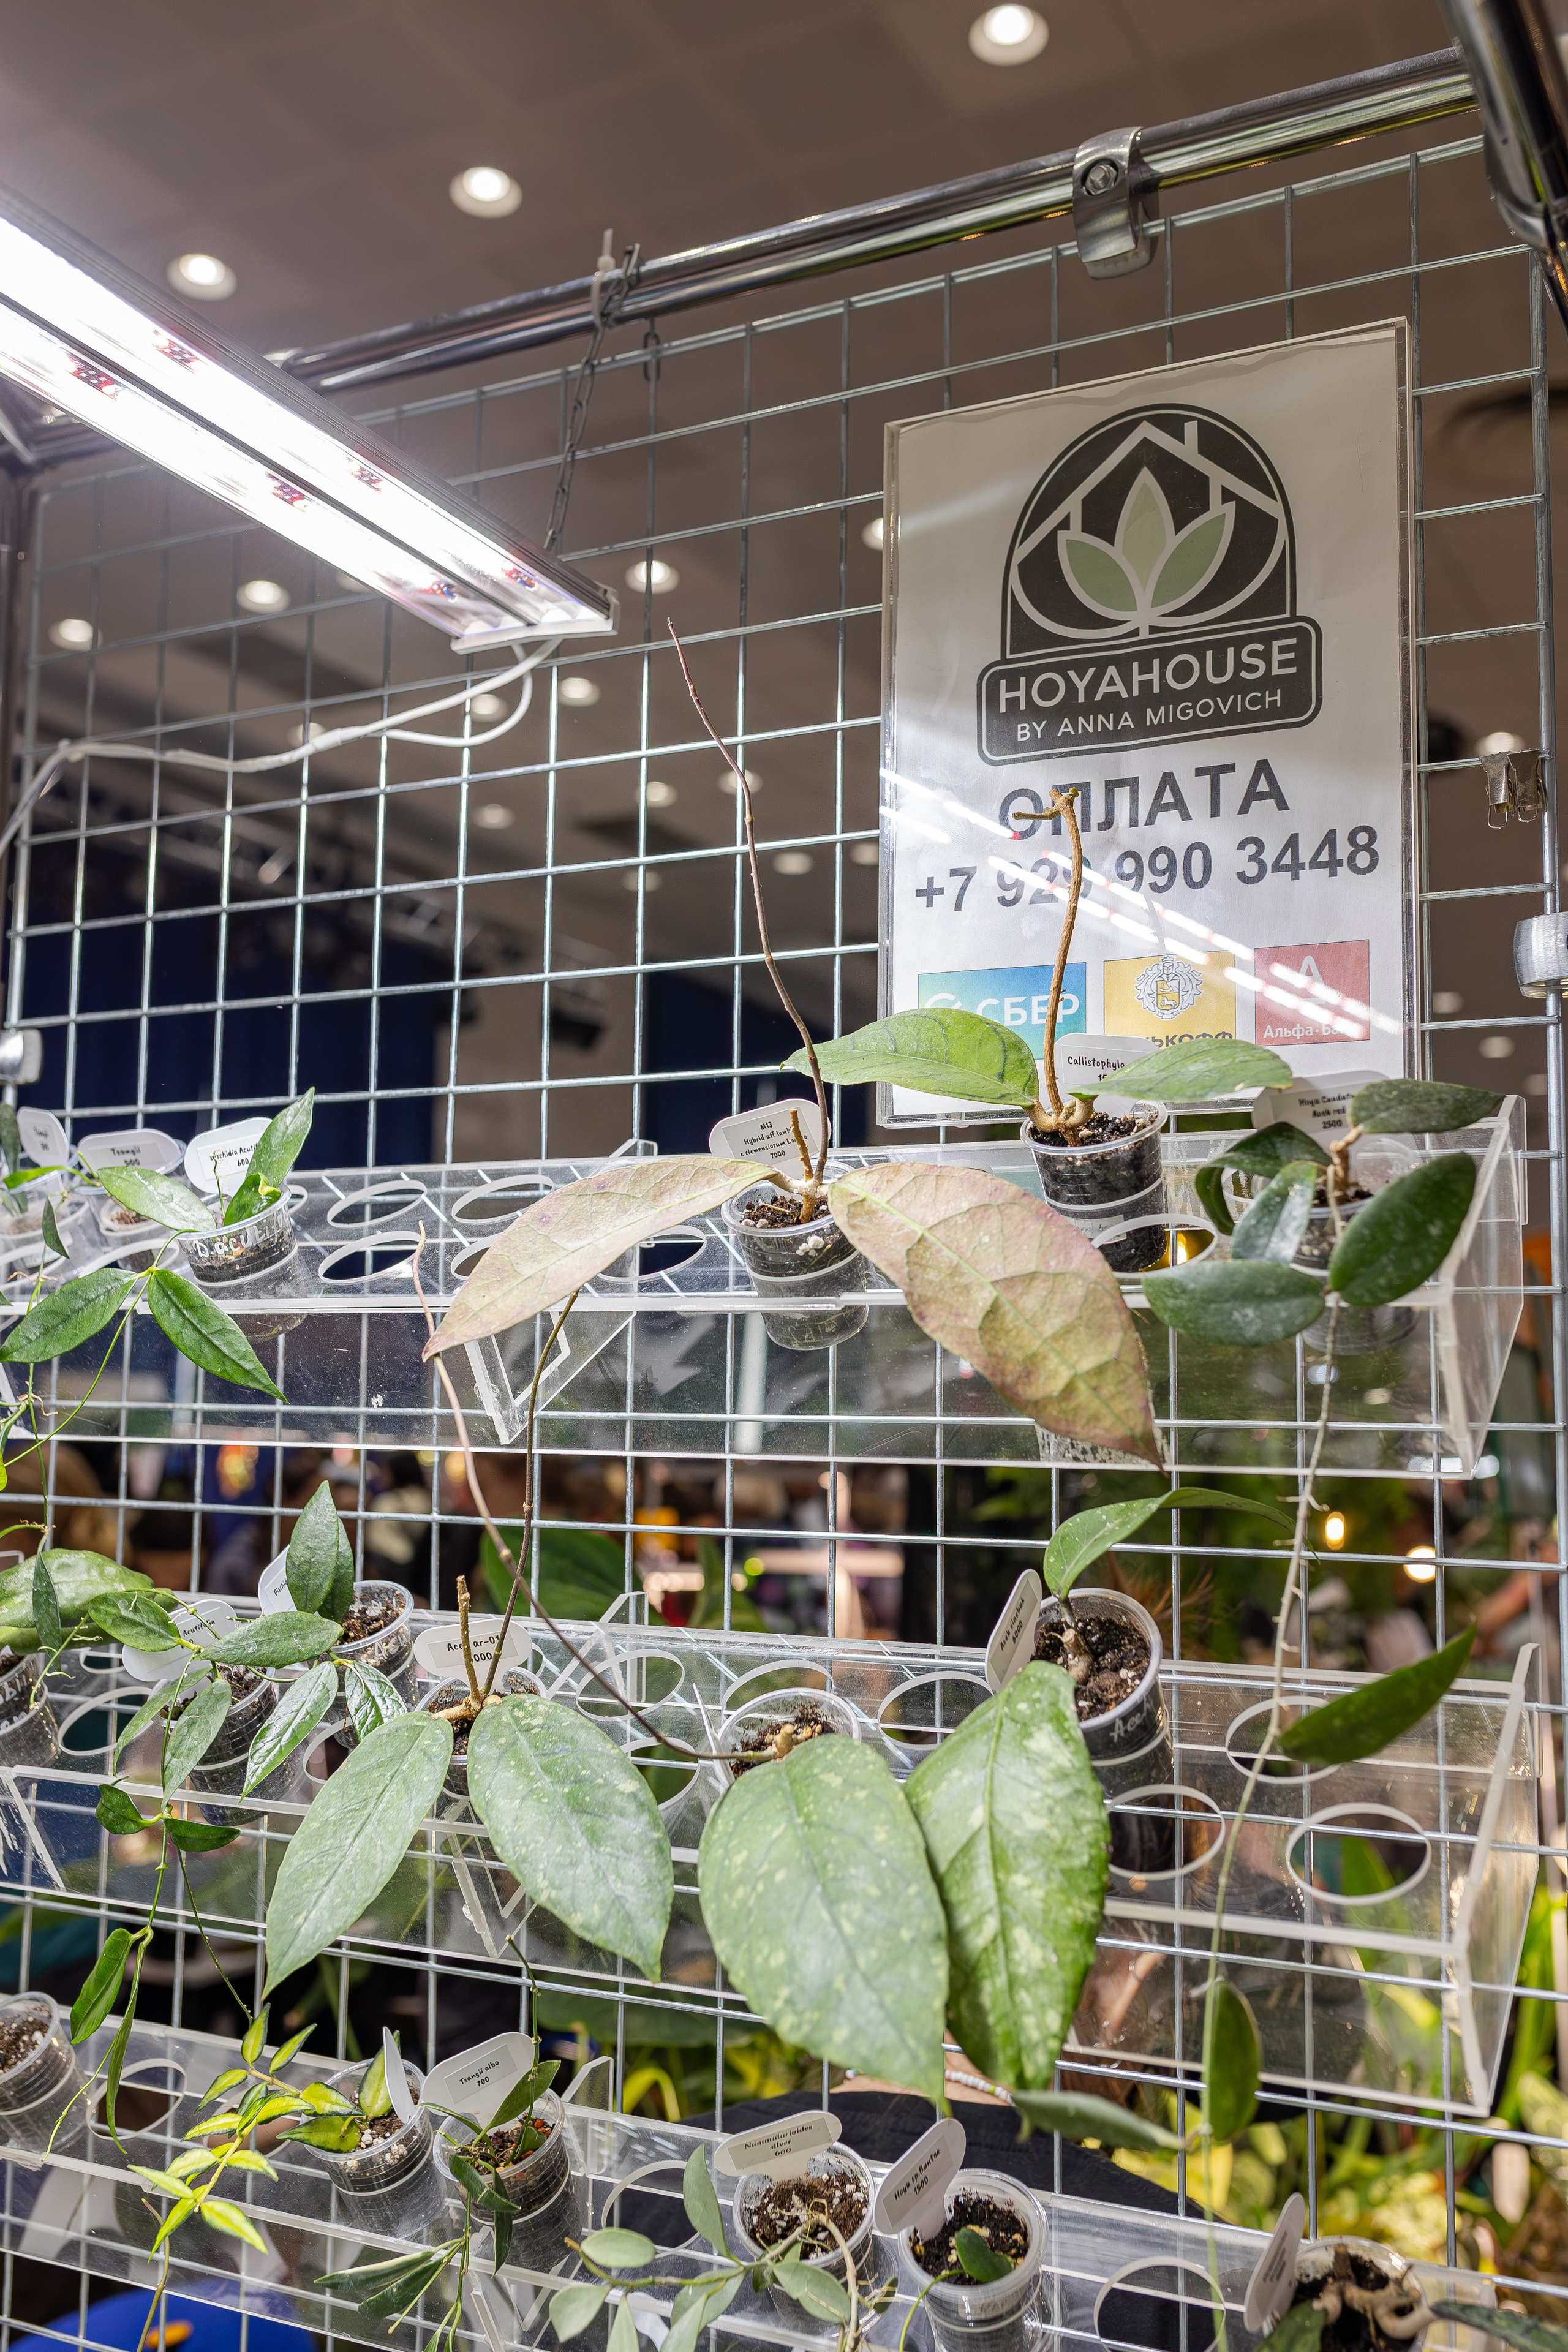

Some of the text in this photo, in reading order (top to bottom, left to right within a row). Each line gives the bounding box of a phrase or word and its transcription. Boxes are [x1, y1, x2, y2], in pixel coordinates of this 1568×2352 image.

[999, 638, 1297, 713] HOYAHOUSE
[1017, 688, 1281, 742] BY ANNA MIGOVICH
[999, 759, 1290, 840] ОПЛАТА
[916, 866, 978, 911] +7
[1115, 841, 1212, 894] 990
[1236, 825, 1379, 885] 3448
[976, 993, 1079, 1027] СБЕР
[760, 1121, 773, 1131] M13
[744, 1134, 766, 1145] Hybrid
[766, 1131, 775, 1140] aff
[745, 1141, 786, 1156] clemensiorum
[770, 1150, 786, 1159] 7000
[237, 1158, 249, 1167] 600
[472, 1651, 492, 1662] 000
[459, 2060, 500, 2085] Tsangii albo
[476, 2076, 490, 2087] 700
[770, 2139, 792, 2150] silver
[894, 2183, 911, 2201] Hoya
[913, 2176, 929, 2196] 1500
